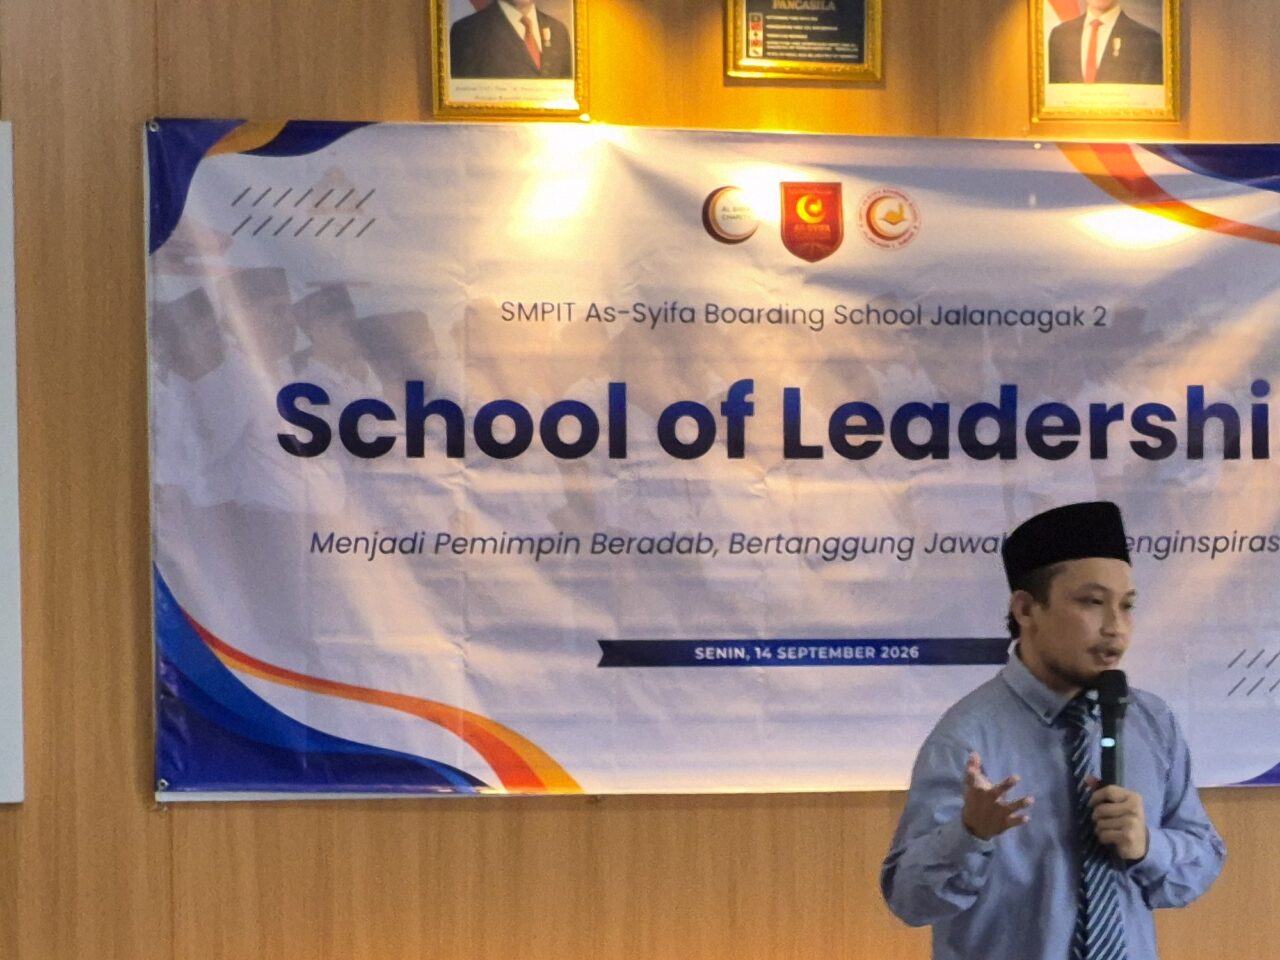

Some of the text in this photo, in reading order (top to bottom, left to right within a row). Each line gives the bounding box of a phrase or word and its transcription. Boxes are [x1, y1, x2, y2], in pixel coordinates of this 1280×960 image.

[501, 301, 1106, 333] SMPIT As-Syifa Boarding School Jalancagak 2
[277, 380, 627, 460] School
[657, 379, 754, 460] of
[311, 531, 425, 561] Menjadi
[434, 531, 580, 562] Pemimpin
[591, 532, 718, 558] Beradab,
[729, 533, 913, 561] Bertanggung
[695, 646, 919, 660] SENIN, 14 SEPTEMBER 2026
